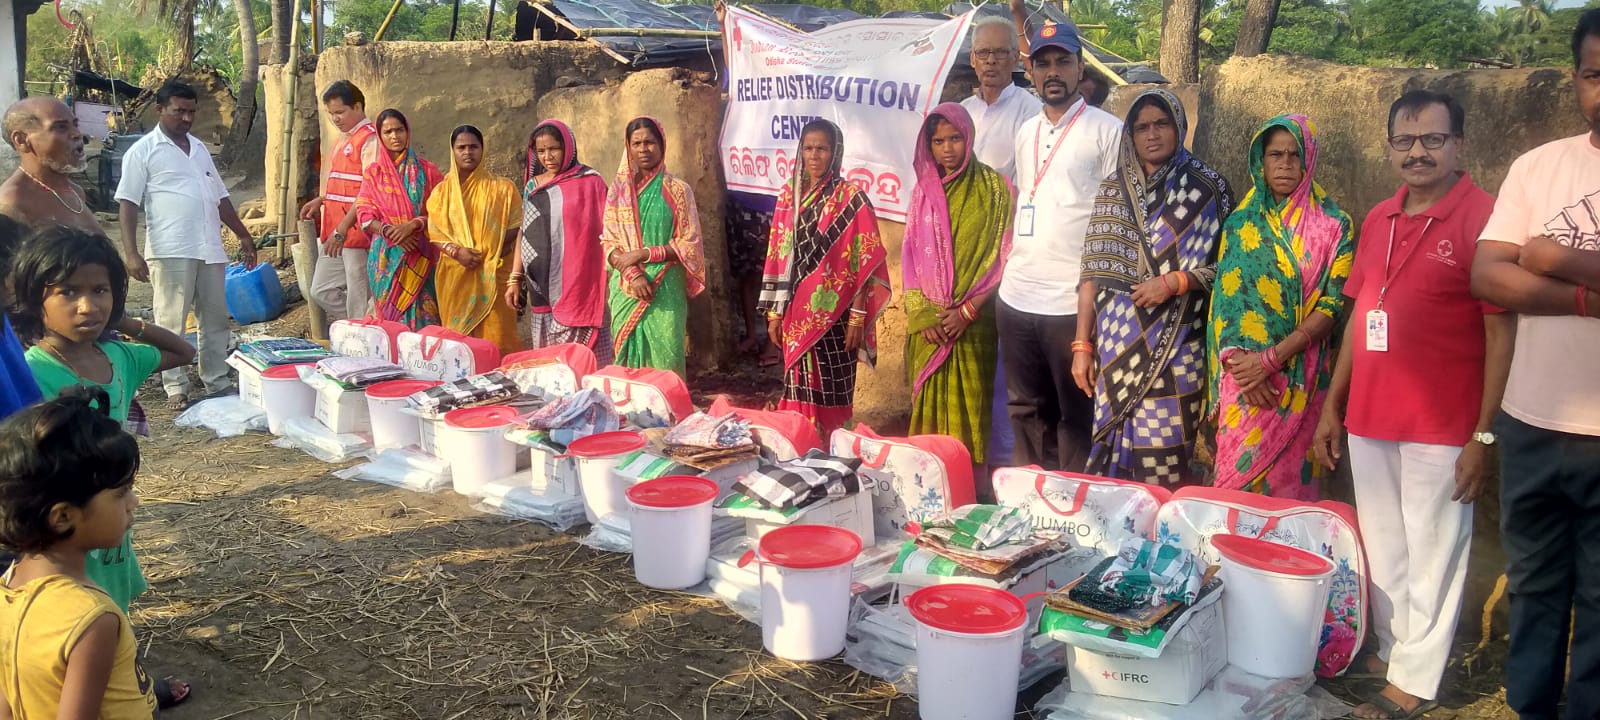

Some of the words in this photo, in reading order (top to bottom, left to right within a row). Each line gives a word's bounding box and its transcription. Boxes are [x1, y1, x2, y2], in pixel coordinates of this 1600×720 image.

[737, 78, 772, 101] RELIEF
[776, 74, 921, 112] DISTRIBUTION
[771, 115, 823, 139] CENT
[1032, 515, 1091, 537] JUMBO
[1120, 672, 1149, 684] IFRC
